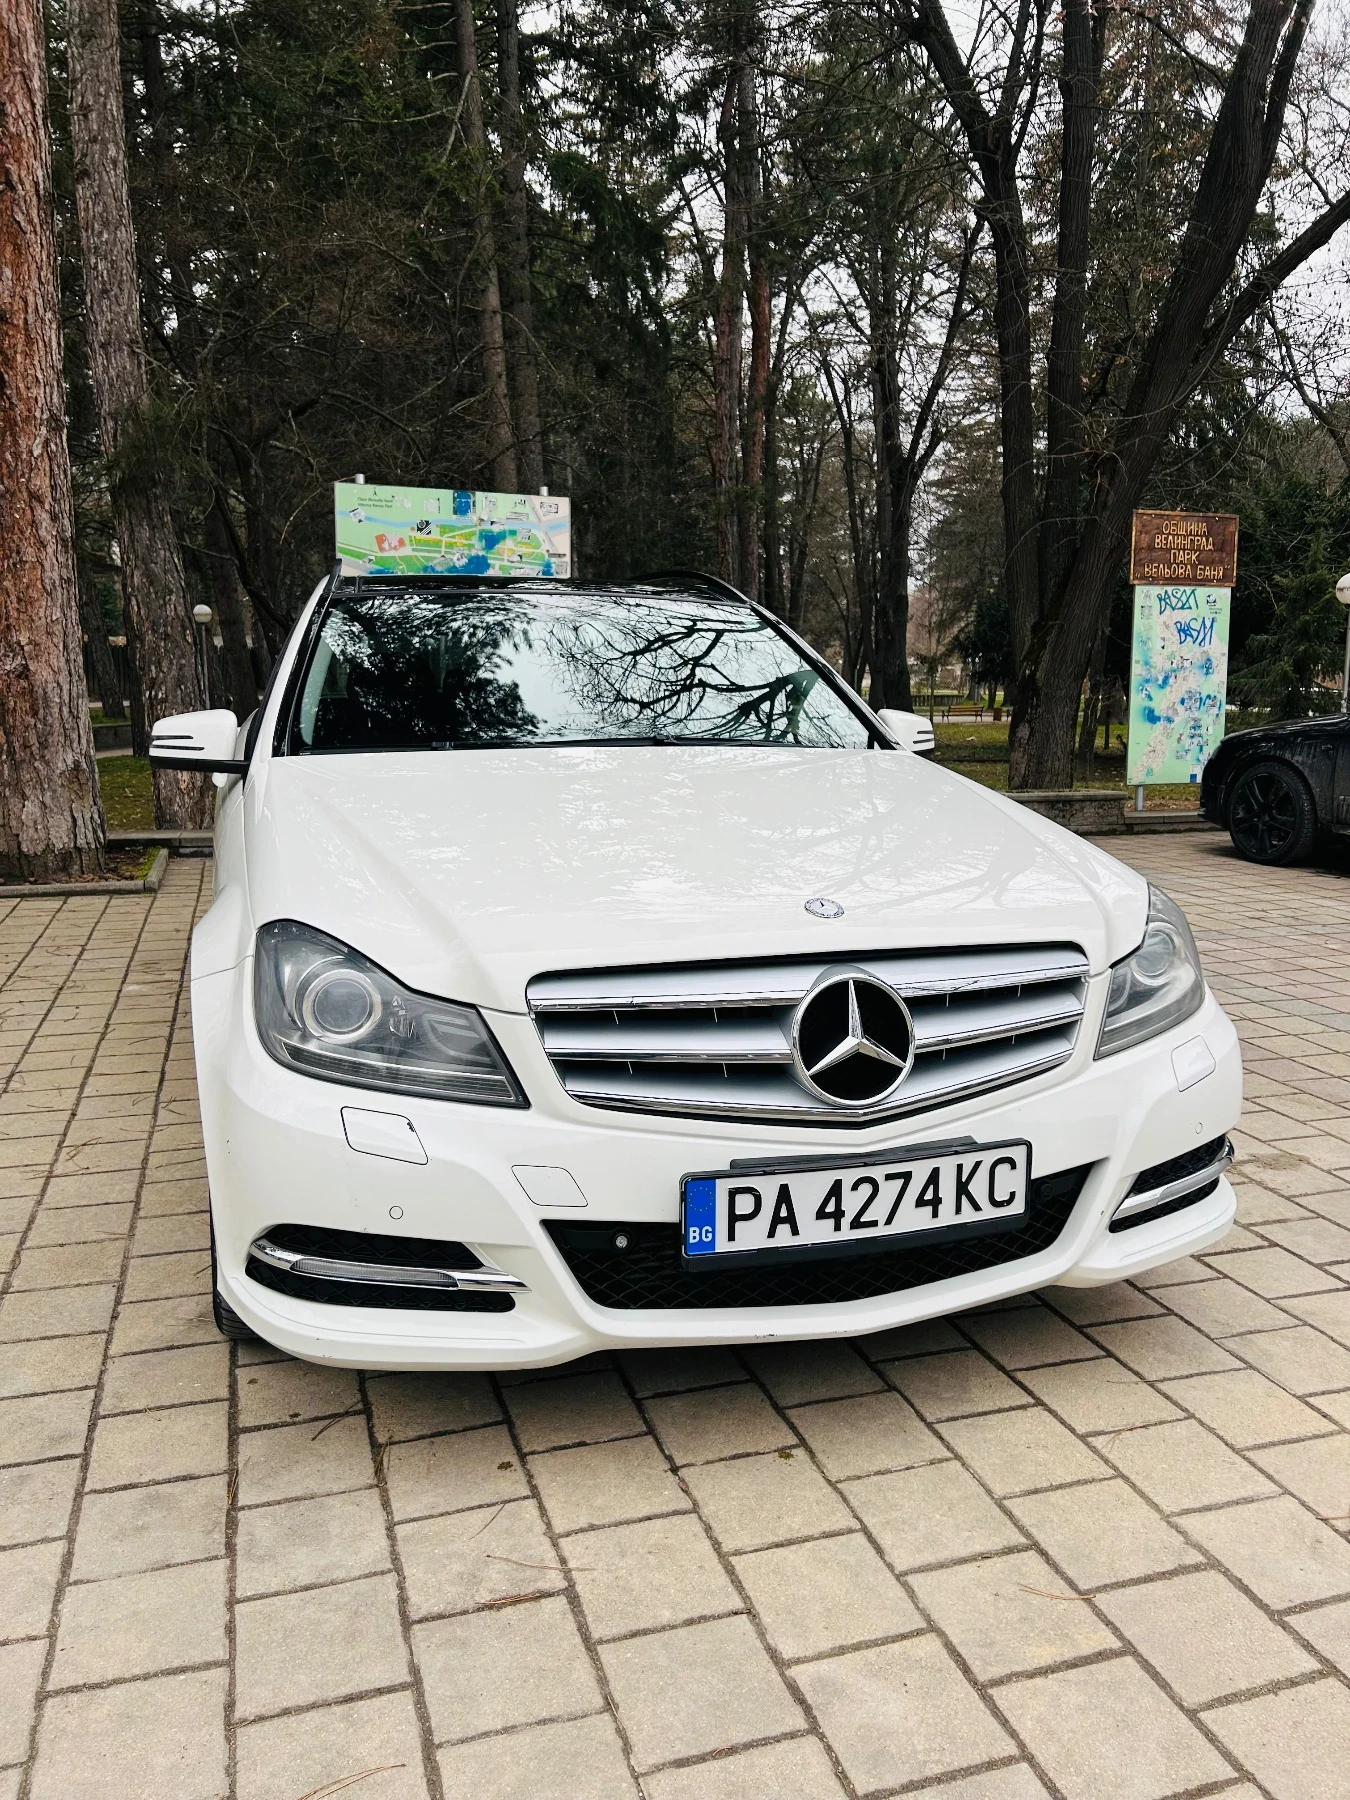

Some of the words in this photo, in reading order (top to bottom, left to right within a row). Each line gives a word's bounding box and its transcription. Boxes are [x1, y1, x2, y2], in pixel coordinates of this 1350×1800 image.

[1162, 520, 1208, 536] ОБЩИНА
[1154, 534, 1214, 550] ВЕЛИНГРАД
[1170, 549, 1199, 564] ПАРК
[727, 1183, 800, 1242] PA
[815, 1166, 943, 1232] 4274
[954, 1156, 1017, 1215] KC
[688, 1226, 713, 1244] BG
